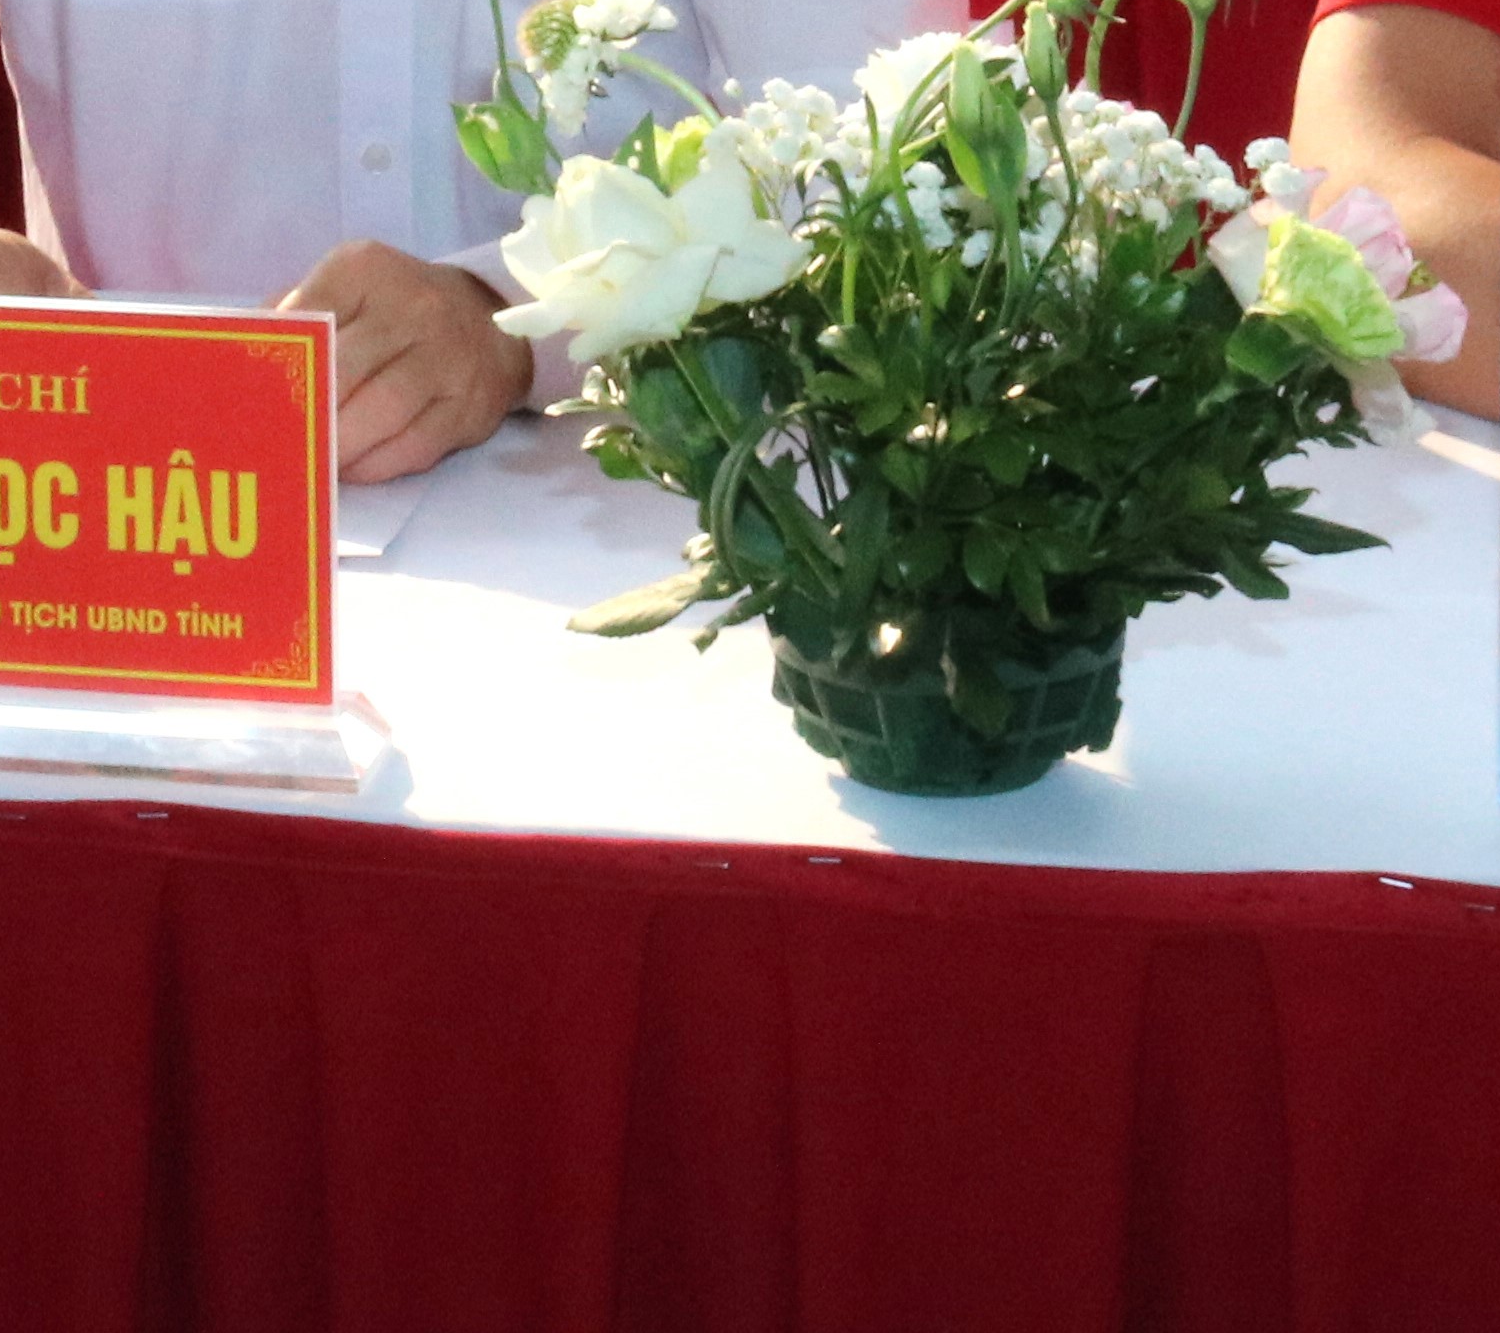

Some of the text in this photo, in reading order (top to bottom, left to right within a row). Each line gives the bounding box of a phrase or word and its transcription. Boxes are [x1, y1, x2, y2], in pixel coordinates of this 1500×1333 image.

[106, 448, 259, 576] HẬU
[9, 600, 78, 634] TỊCH
[87, 605, 168, 635] UBND
[175, 602, 244, 639] TỈNH
